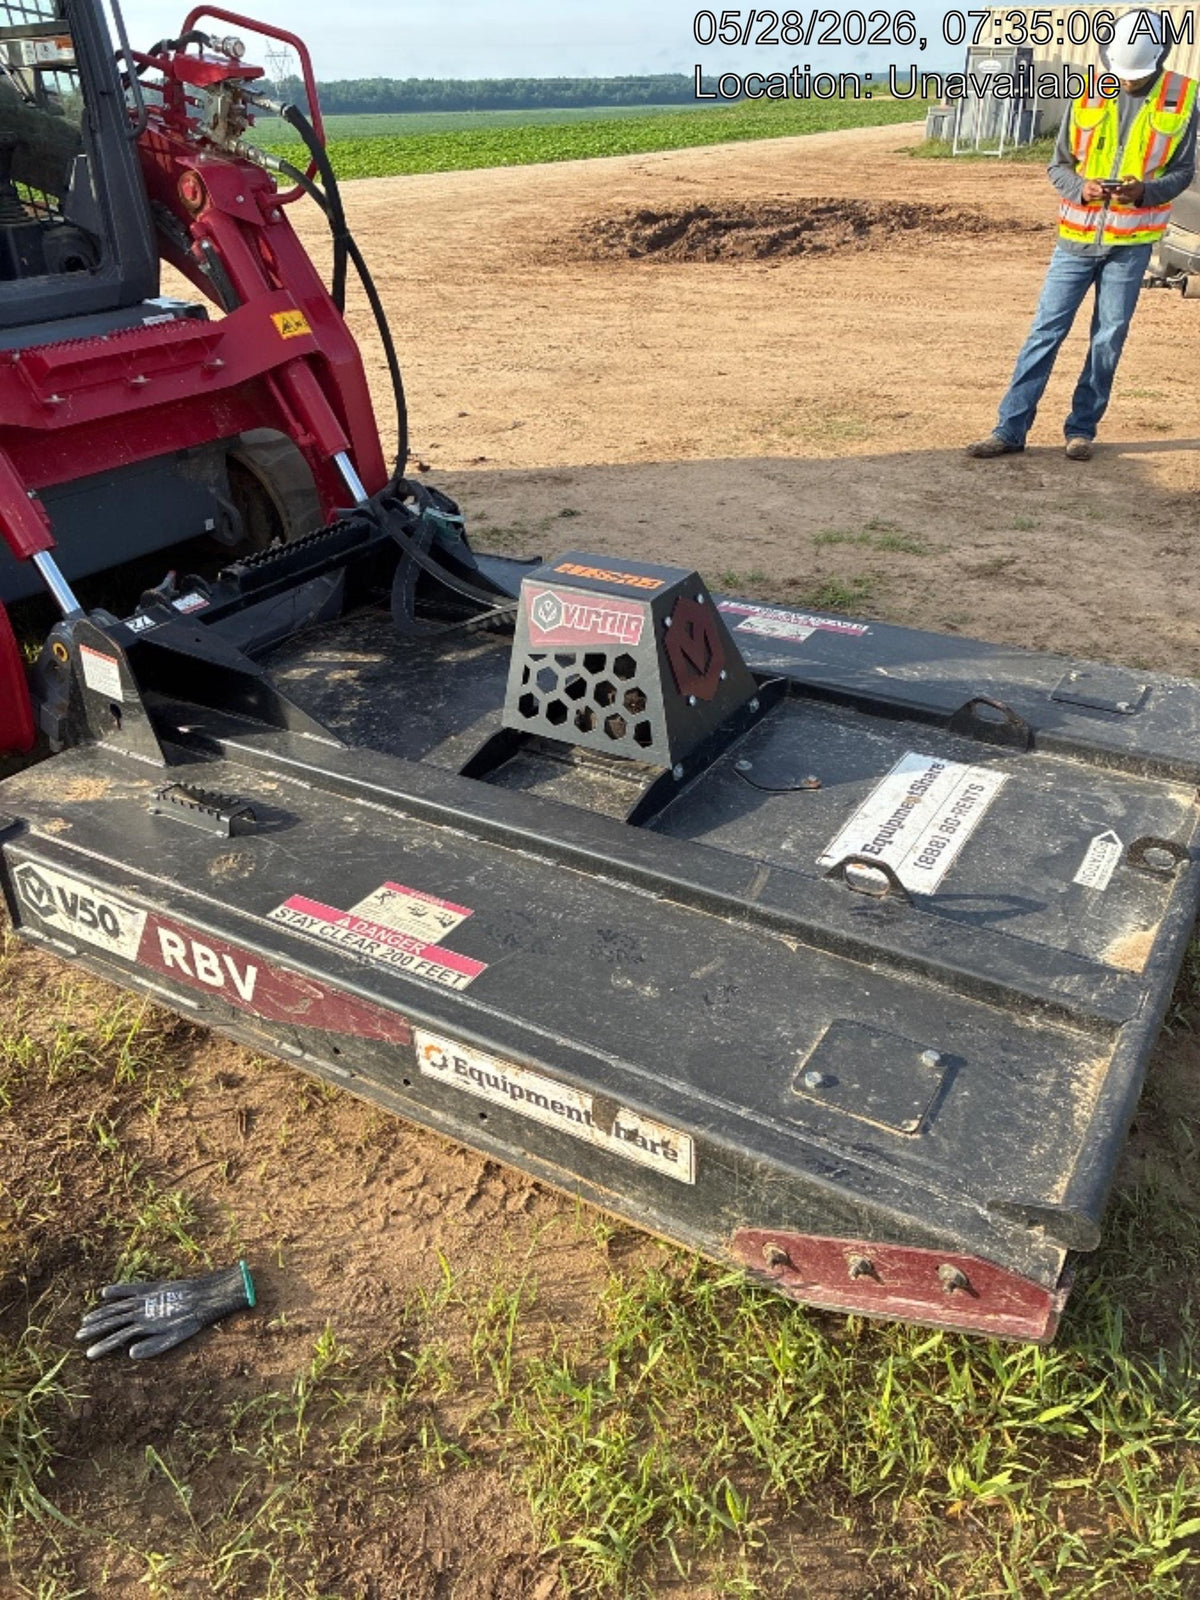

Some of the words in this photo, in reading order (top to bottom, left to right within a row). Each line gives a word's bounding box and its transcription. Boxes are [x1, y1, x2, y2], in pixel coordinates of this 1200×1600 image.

[861, 761, 945, 856] EquipmetShare
[56, 886, 120, 939] V50
[275, 907, 320, 930] STAY
[319, 925, 381, 954] CLEAR
[380, 947, 414, 966] 200
[414, 961, 469, 985] FEET
[353, 920, 427, 955] DANGER
[156, 926, 258, 1002] RBV
